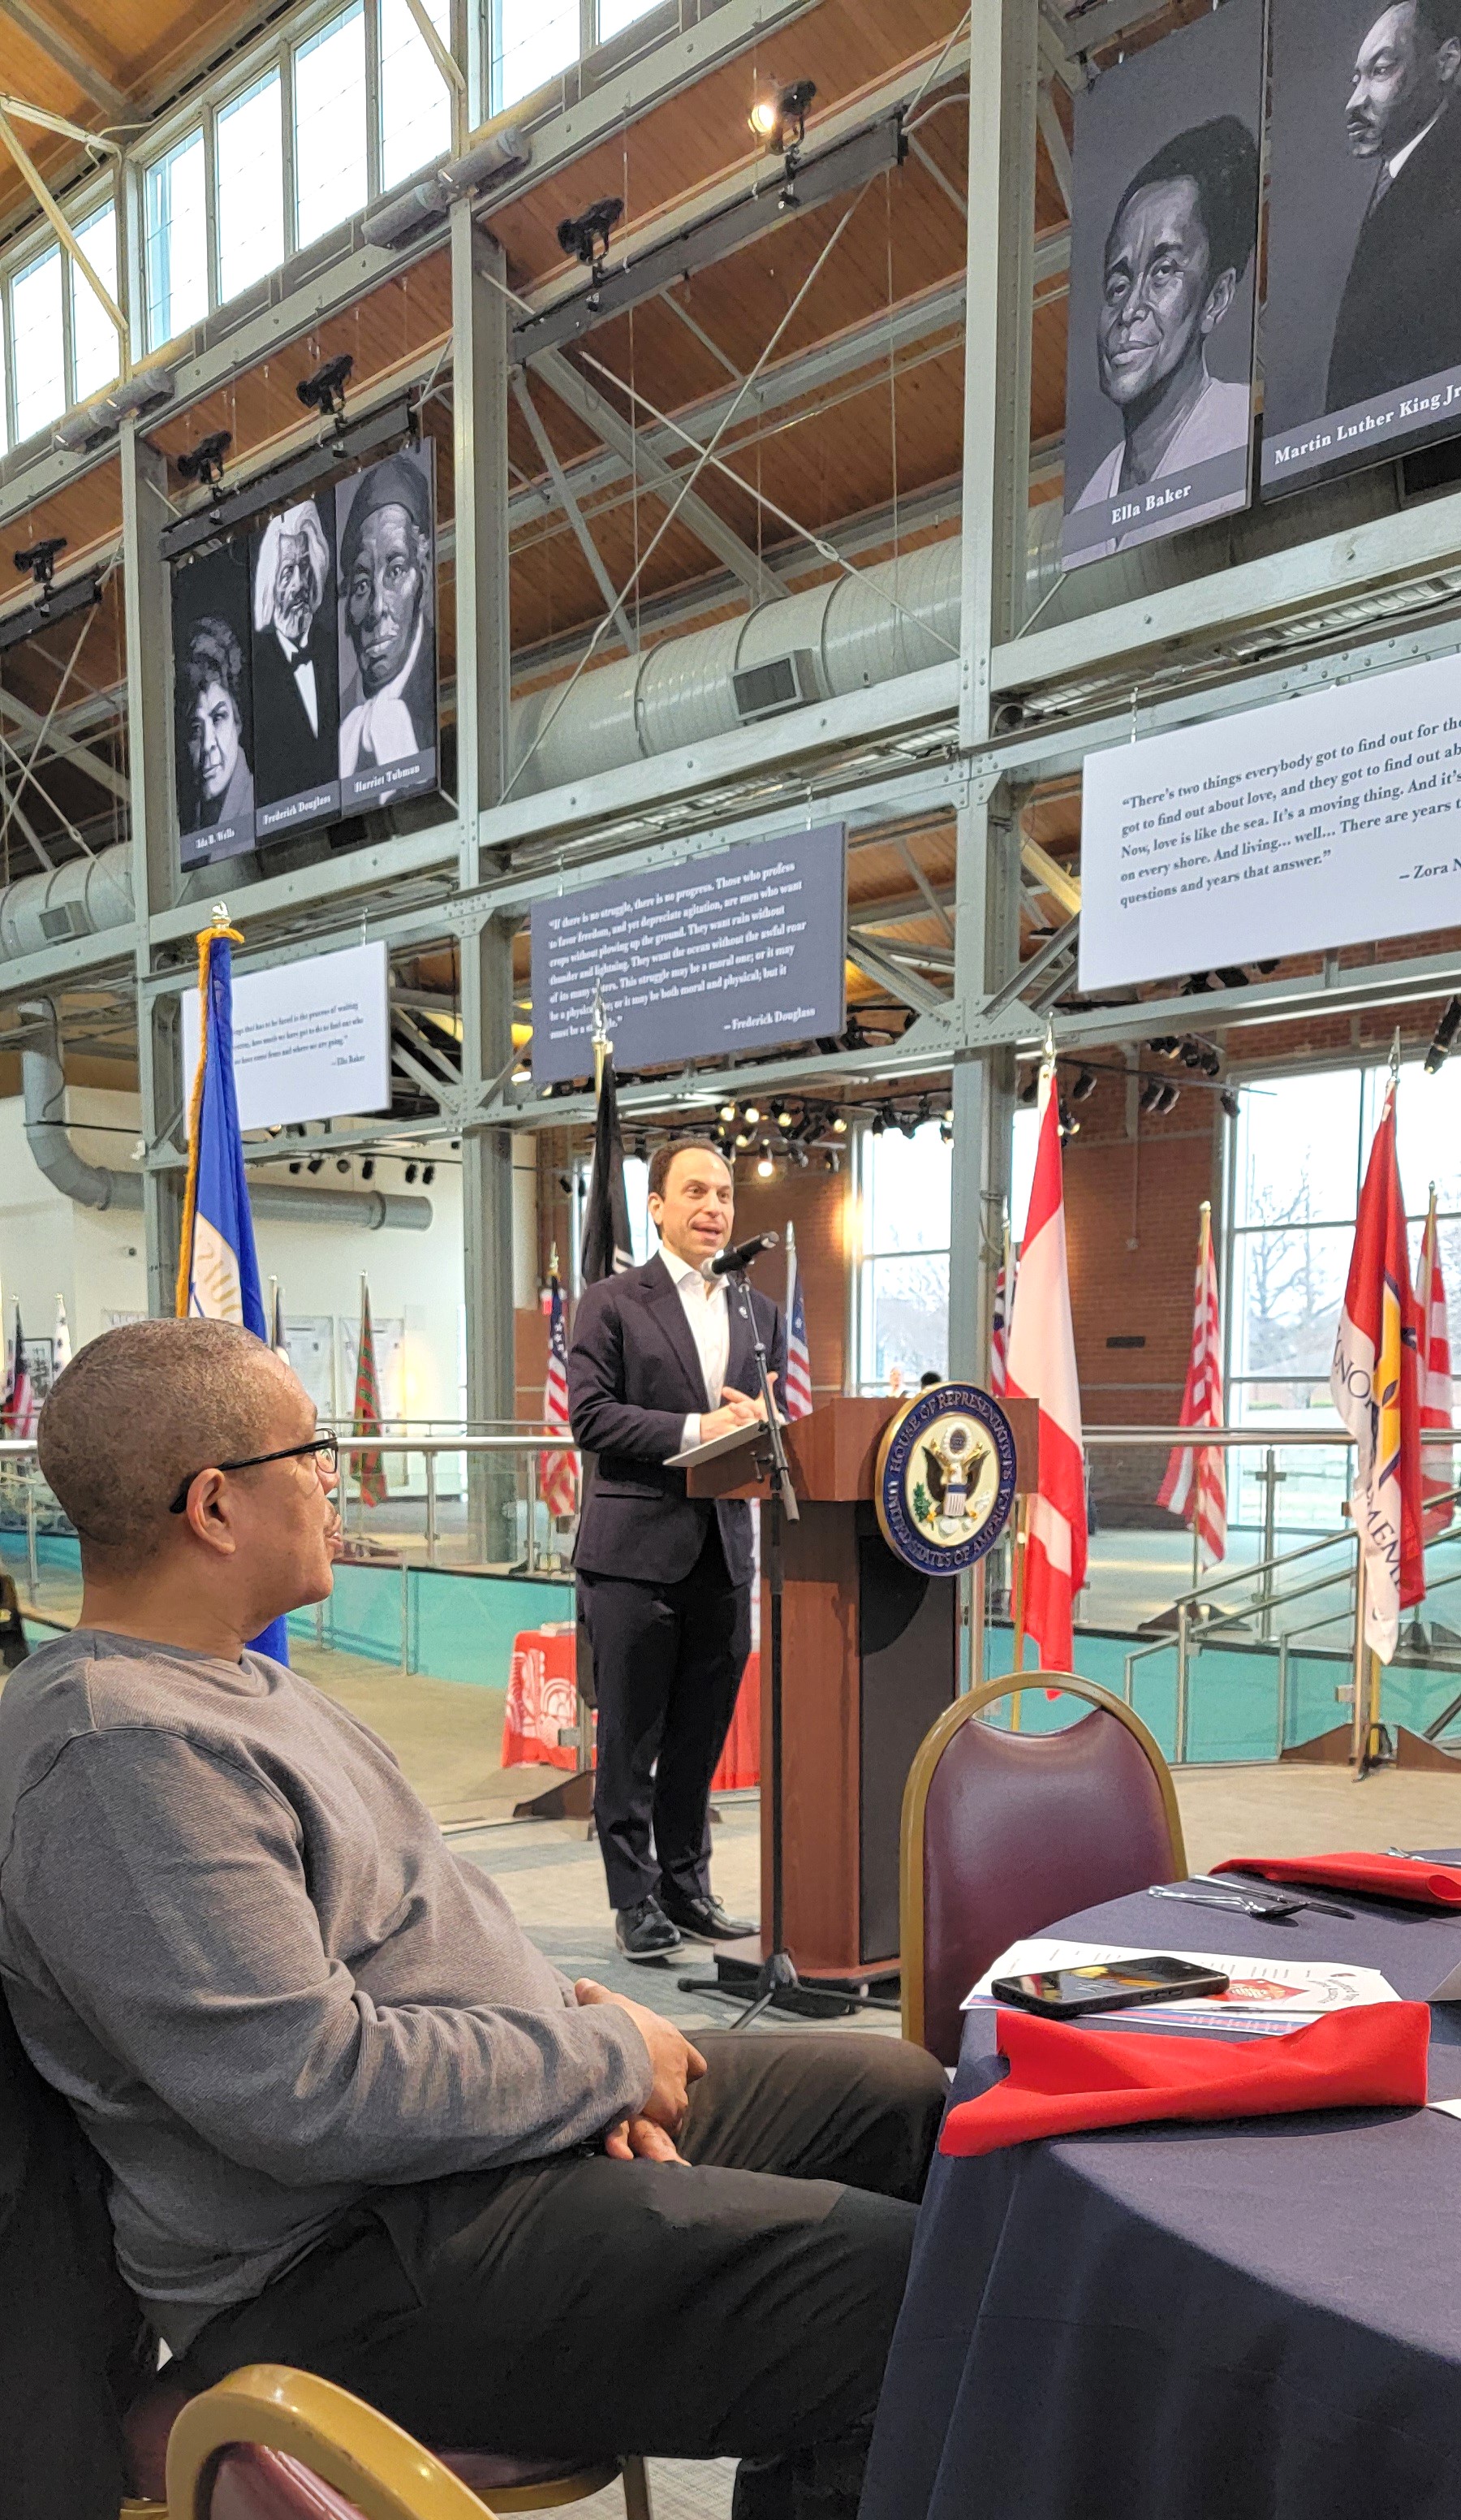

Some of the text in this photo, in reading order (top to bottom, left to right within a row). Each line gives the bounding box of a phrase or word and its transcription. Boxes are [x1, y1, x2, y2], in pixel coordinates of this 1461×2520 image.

[1274, 435, 1332, 465] Martin
[1337, 412, 1394, 441] Luther
[1399, 395, 1441, 418] King
[1111, 483, 1192, 524] Ella Baker
[354, 765, 420, 793] Harriet Tubman
[1123, 788, 1174, 809] "There's
[1178, 784, 1200, 796] two
[1203, 774, 1242, 791] things
[1245, 753, 1312, 779] everybody
[1316, 749, 1337, 766] got
[1341, 746, 1354, 757] to
[1358, 734, 1386, 753] find
[1390, 730, 1413, 744] out
[1417, 724, 1439, 738] for
[263, 795, 331, 826] Frederick Douglass
[1122, 749, 1440, 838] got to find out about love, and they got to find out
[1122, 844, 1150, 858] Now,
[1153, 839, 1178, 851] love
[1181, 832, 1191, 844] is
[1195, 827, 1217, 841] like
[1221, 822, 1240, 835] the
[1243, 818, 1269, 830] sea.
[1274, 808, 1294, 823] It's
[1298, 809, 1305, 818] a
[1309, 796, 1360, 815] moving
[1364, 787, 1403, 802] thing.
[1407, 775, 1437, 793] And
[196, 837, 209, 849] Ida
[218, 828, 235, 841] Wells
[1121, 872, 1135, 882] on
[1139, 864, 1170, 878] every
[1174, 856, 1210, 869] shore.
[1214, 844, 1239, 861] And
[1242, 839, 1291, 855] living...
[1295, 826, 1335, 843] well...
[1339, 818, 1381, 833] There
[1385, 812, 1408, 824] are
[1412, 802, 1451, 822] years
[1120, 849, 1331, 908] questions and years that answer."
[1413, 865, 1448, 879] Zora
[920, 1398, 936, 1419] OF
[954, 1546, 970, 1565] OF
